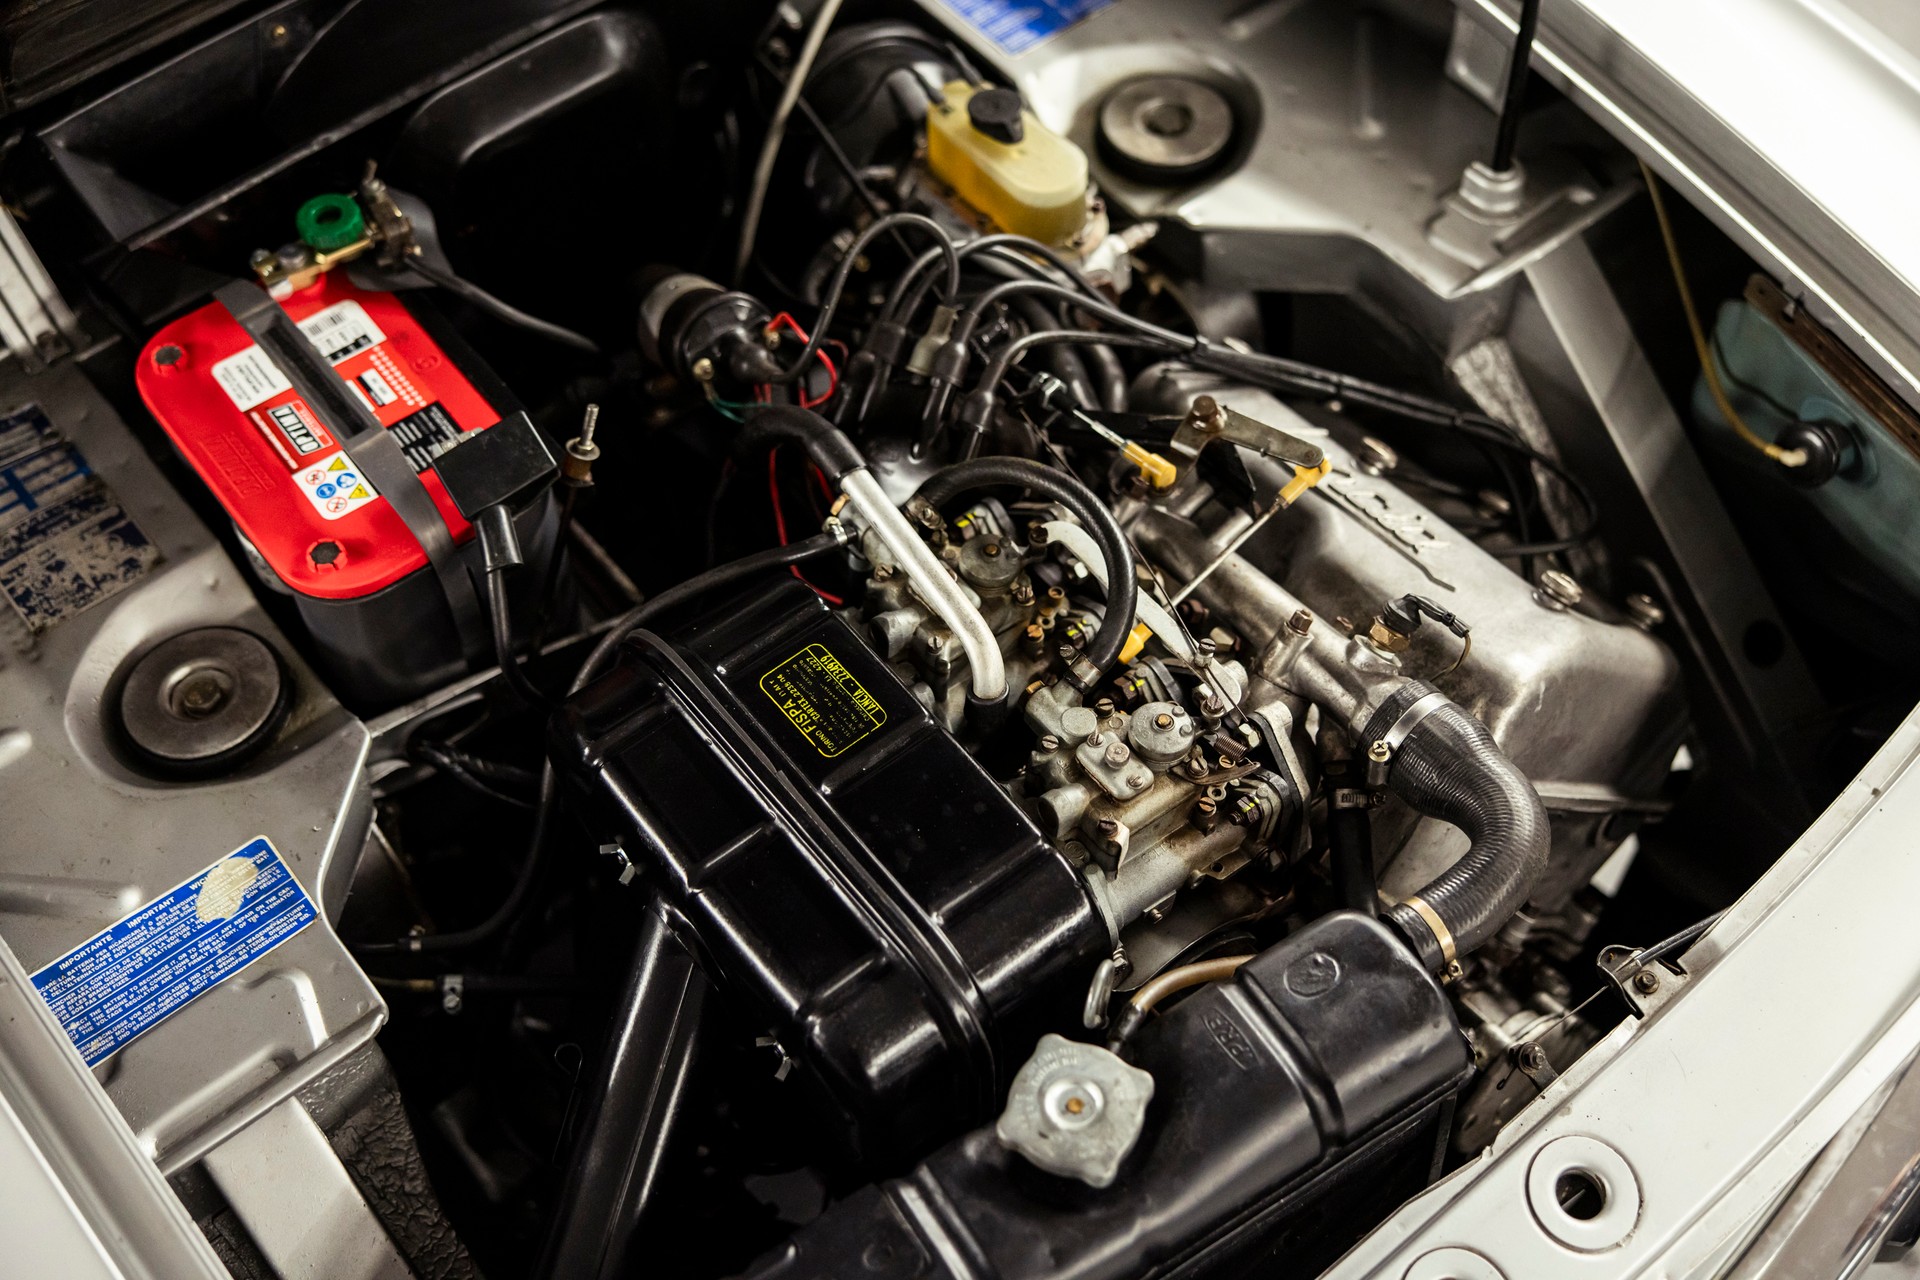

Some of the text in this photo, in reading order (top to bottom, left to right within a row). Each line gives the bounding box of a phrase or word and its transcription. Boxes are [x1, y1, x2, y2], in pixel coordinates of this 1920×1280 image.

[272, 404, 319, 453] OPTIMA
[805, 655, 823, 672] 4227
[819, 653, 850, 683] 2234919
[781, 697, 817, 733] FISPA
[851, 687, 879, 715] LANCIA
[814, 729, 837, 752] TORINO
[66, 956, 95, 976] BATTERIA
[96, 948, 108, 957] PER
[108, 925, 145, 950] RICARICARLA
[155, 911, 167, 921] PER
[169, 893, 197, 912] ESEGUIRE
[126, 895, 176, 928] IMPORTANT
[48, 973, 75, 992] VETTURA
[80, 962, 94, 973] NON
[95, 951, 111, 964] FARE
[111, 929, 148, 953] FUNZIONARE
[155, 910, 179, 926] MOTORE
[50, 960, 107, 997] DELL'ALTERNATORE
[113, 948, 126, 958] SUO
[127, 924, 165, 950] REGOLATORE
[165, 915, 179, 926] NON
[58, 933, 113, 970] IMPORTANTE
[74, 996, 87, 1006] LES
[87, 967, 134, 998] BRANCHEMENTS
[134, 961, 143, 969] DE
[143, 955, 152, 963] LA
[182, 930, 191, 938] DE
[245, 888, 258, 898] SON
[76, 983, 88, 993] LES
[89, 963, 121, 985] CONTACTS
[121, 957, 131, 965] DE
[131, 951, 140, 959] LA
[139, 934, 168, 954] ATTERIE
[169, 923, 186, 935] POUR
[77, 1020, 91, 1031] RUN
[92, 1012, 105, 1022] THE
[105, 997, 128, 1014] ENGINE
[136, 984, 148, 994] THE
[148, 957, 190, 986] CONNECTIONS
[189, 952, 199, 960] OF
[198, 944, 211, 954] THE
[247, 913, 259, 922] THE
[258, 889, 295, 915] ALTERNATOR
[89, 1007, 101, 1018] THE
[102, 990, 129, 1009] BATTERY
[129, 984, 138, 992] TO
[138, 964, 170, 986] RECHARGE
[177, 952, 187, 961] OR
[187, 946, 197, 954] TO
[197, 932, 219, 948] EFFECT
[219, 923, 233, 933] ANY
[233, 909, 254, 925] REPAIR
[254, 903, 264, 911] ON
[264, 895, 277, 904] THE
[103, 955, 143, 982] QUELCONQUE
[143, 947, 156, 957] SUR
[165, 925, 191, 943] VOITURE
[70, 1004, 84, 1015] SON
[84, 996, 97, 1006] PAS
[96, 987, 111, 998] BIEN
[81, 1024, 94, 1035] THE
[95, 1006, 123, 1026] VOLTAGE
[124, 983, 159, 1008] REGULATOR
[160, 974, 173, 985] ARE
[174, 965, 187, 976] NOT
[187, 951, 209, 967] FIRMLY
[117, 1030, 131, 1041] UND
[132, 991, 189, 1031] SPANNUNGSREGLER
[190, 978, 209, 993] NICHT
[249, 920, 298, 954] ANGESCHLOSSEN
[128, 1010, 142, 1021] VOR
[142, 1000, 156, 1012] DEM
[156, 980, 187, 1002] AUFLADEN
[187, 971, 201, 982] UND
[201, 963, 214, 973] VOR
[213, 942, 246, 965] JEGLICHEN
[114, 1019, 137, 1036] MOTOR
[137, 1007, 156, 1021] NICHT
